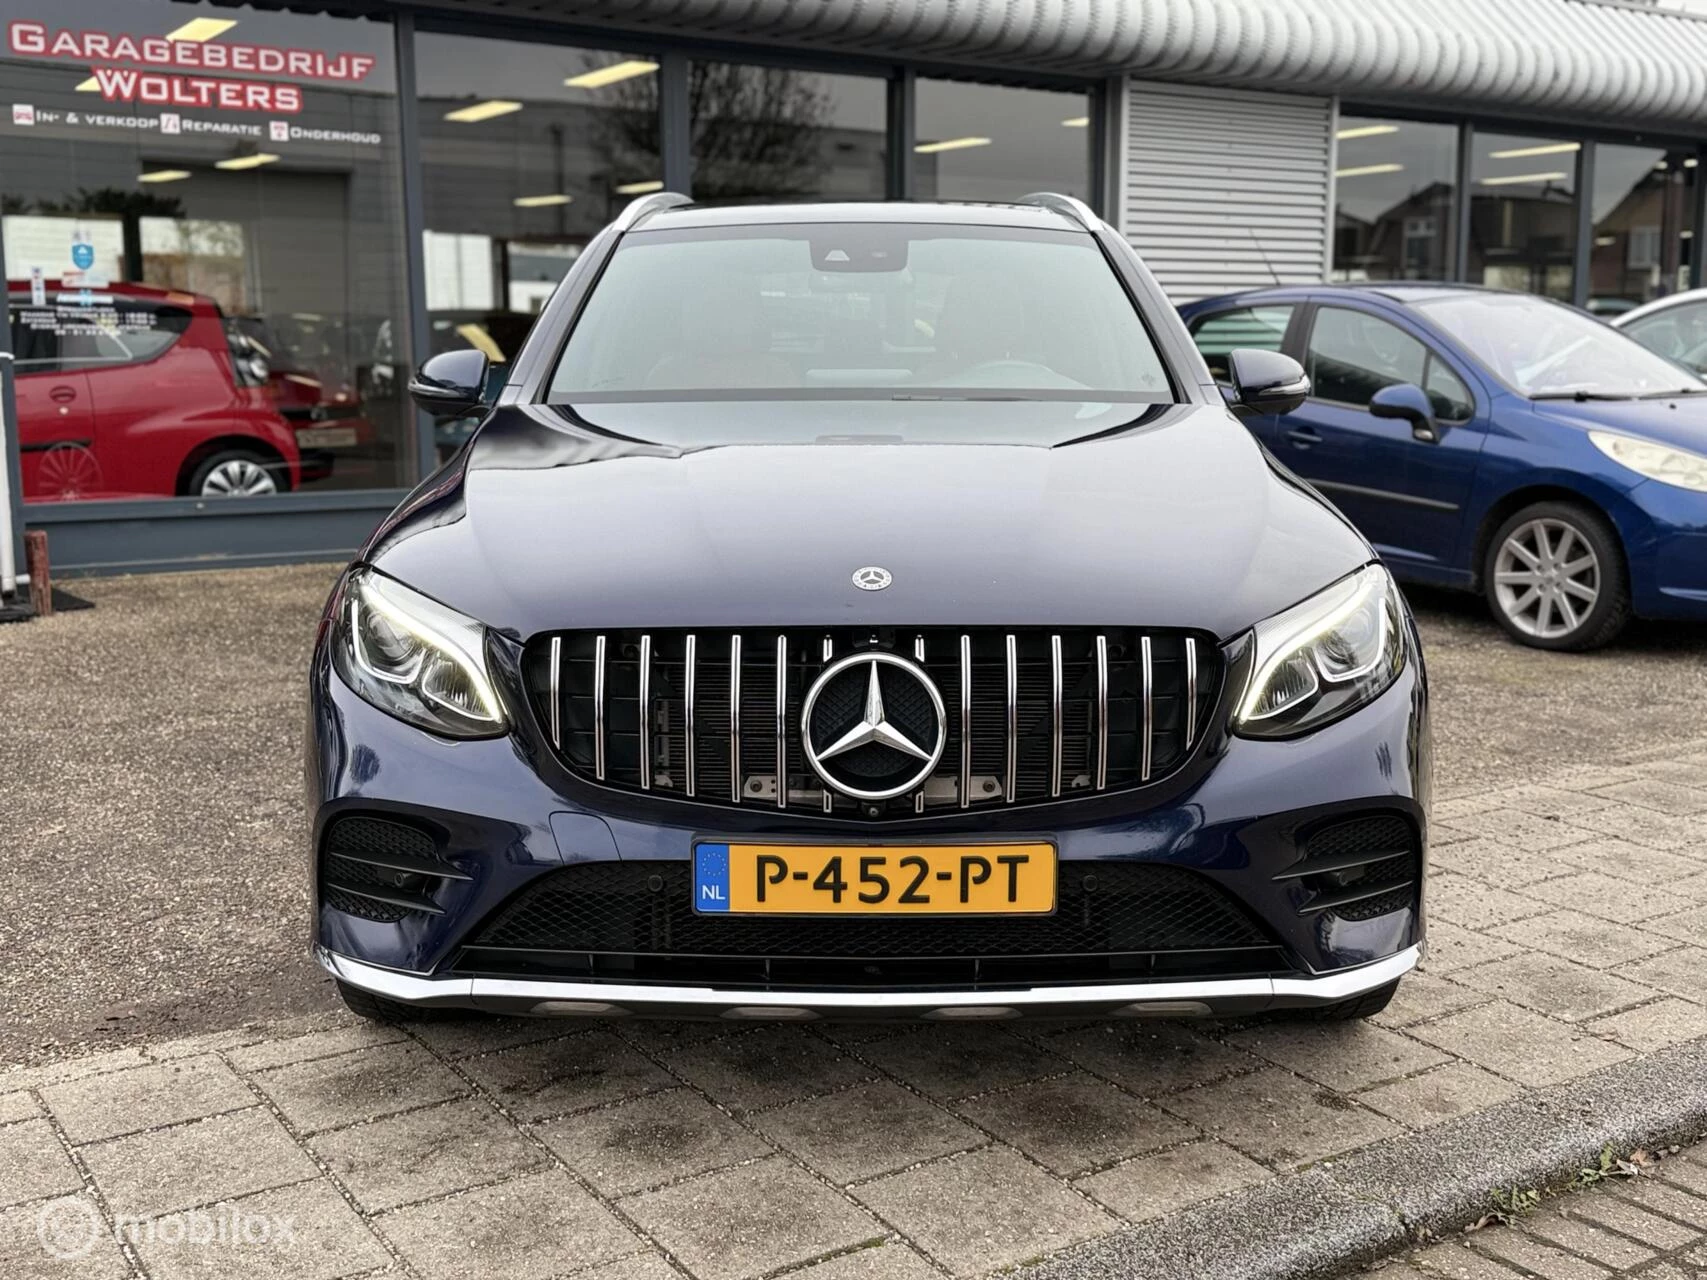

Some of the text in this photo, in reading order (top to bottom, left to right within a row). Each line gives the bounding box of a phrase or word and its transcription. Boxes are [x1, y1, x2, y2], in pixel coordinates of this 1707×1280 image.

[9, 22, 375, 81] GARAGEBEDRIJF
[95, 68, 301, 112] WOLTERS
[65, 112, 79, 124] &
[85, 114, 159, 128] VERKOOP
[182, 119, 262, 136] REPARATIE
[290, 126, 381, 144] ONDERHOUD
[702, 885, 725, 900] NL
[756, 854, 1029, 904] P-452-PT
